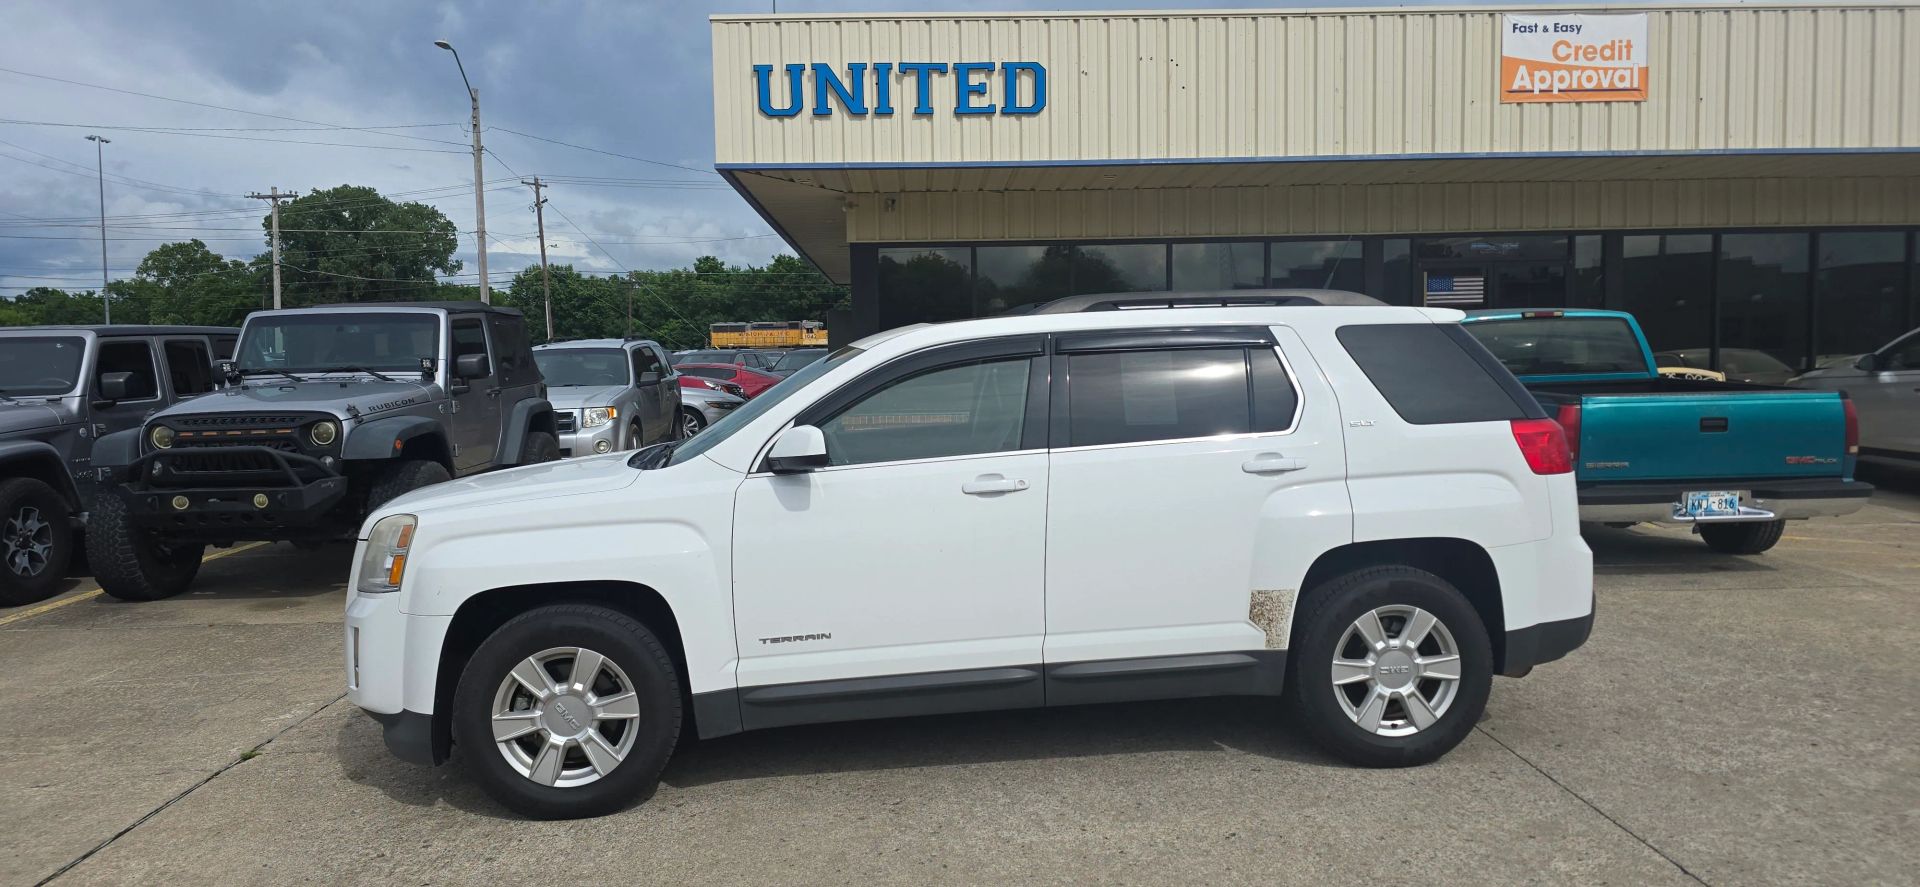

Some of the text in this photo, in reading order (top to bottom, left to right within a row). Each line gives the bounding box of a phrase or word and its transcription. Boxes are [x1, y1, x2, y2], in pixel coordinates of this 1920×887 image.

[1512, 23, 1583, 35] Fast & Easy
[1551, 39, 1633, 62] Credit
[1511, 63, 1640, 95] Approval
[753, 61, 1047, 117] UNITED
[368, 397, 415, 412] RUBICON
[1350, 420, 1376, 428] SLT
[1785, 455, 1815, 464] GMC
[758, 632, 832, 645] TERRAIN
[554, 702, 581, 731] GMC
